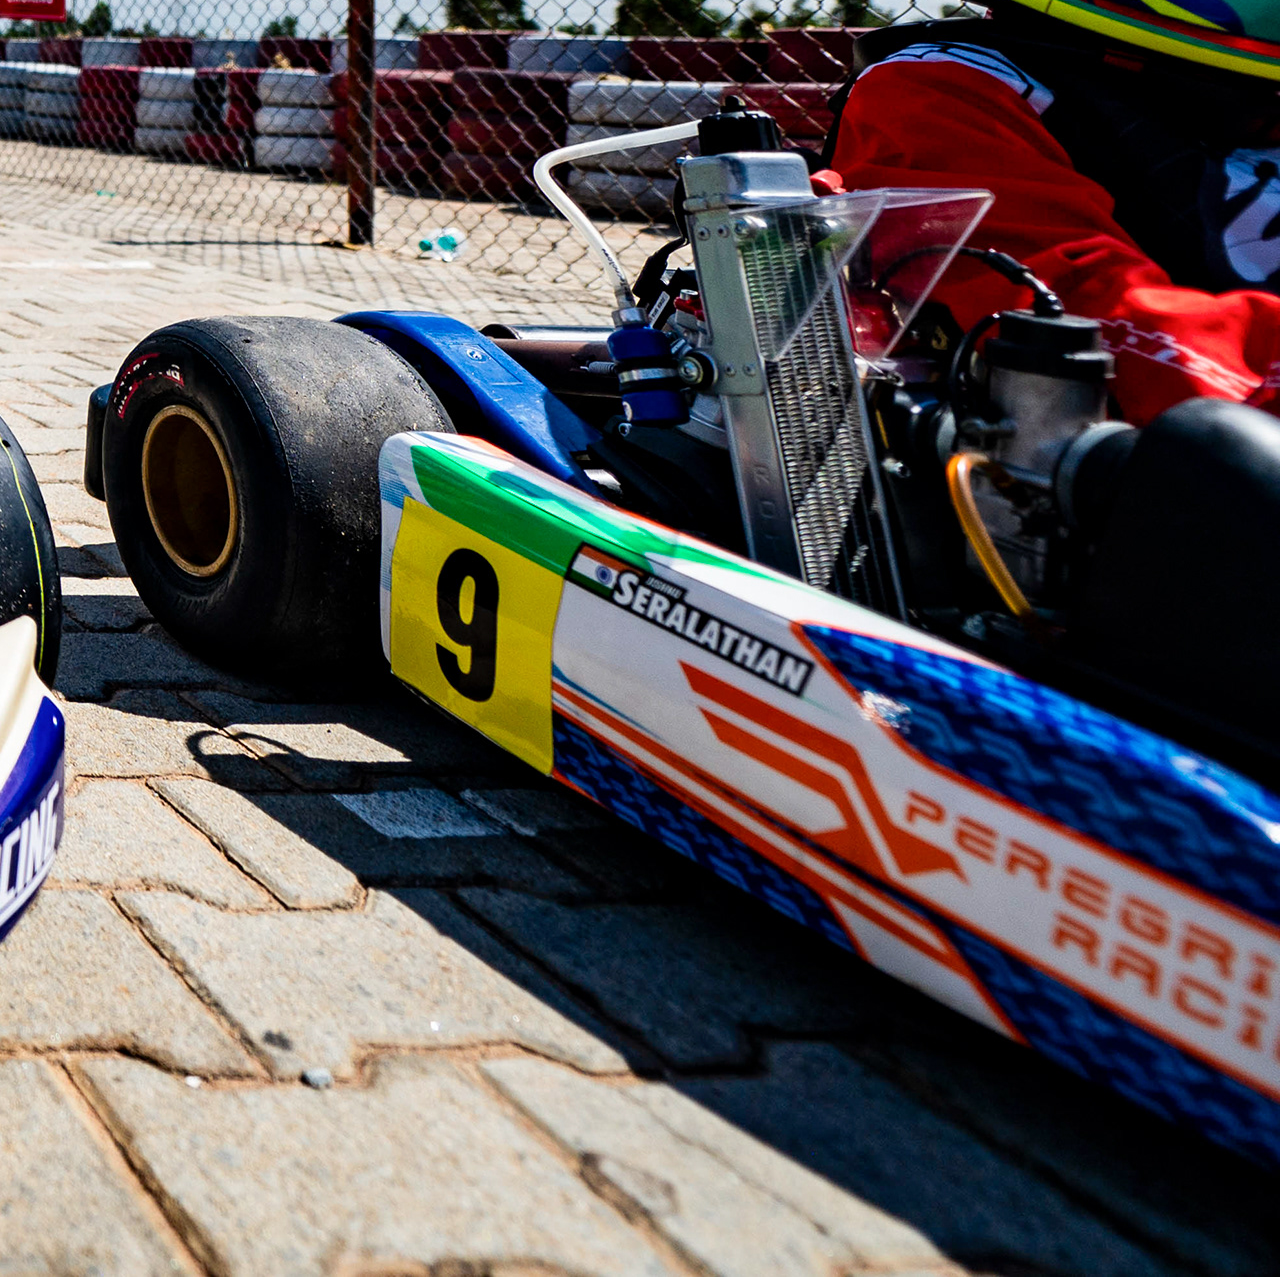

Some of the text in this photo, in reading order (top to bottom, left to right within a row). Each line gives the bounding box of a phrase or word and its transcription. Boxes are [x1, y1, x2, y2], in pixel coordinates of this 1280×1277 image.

[435, 547, 500, 703] 9
[612, 571, 810, 698] SERALATHAN
[1050, 910, 1280, 1064] RACI
